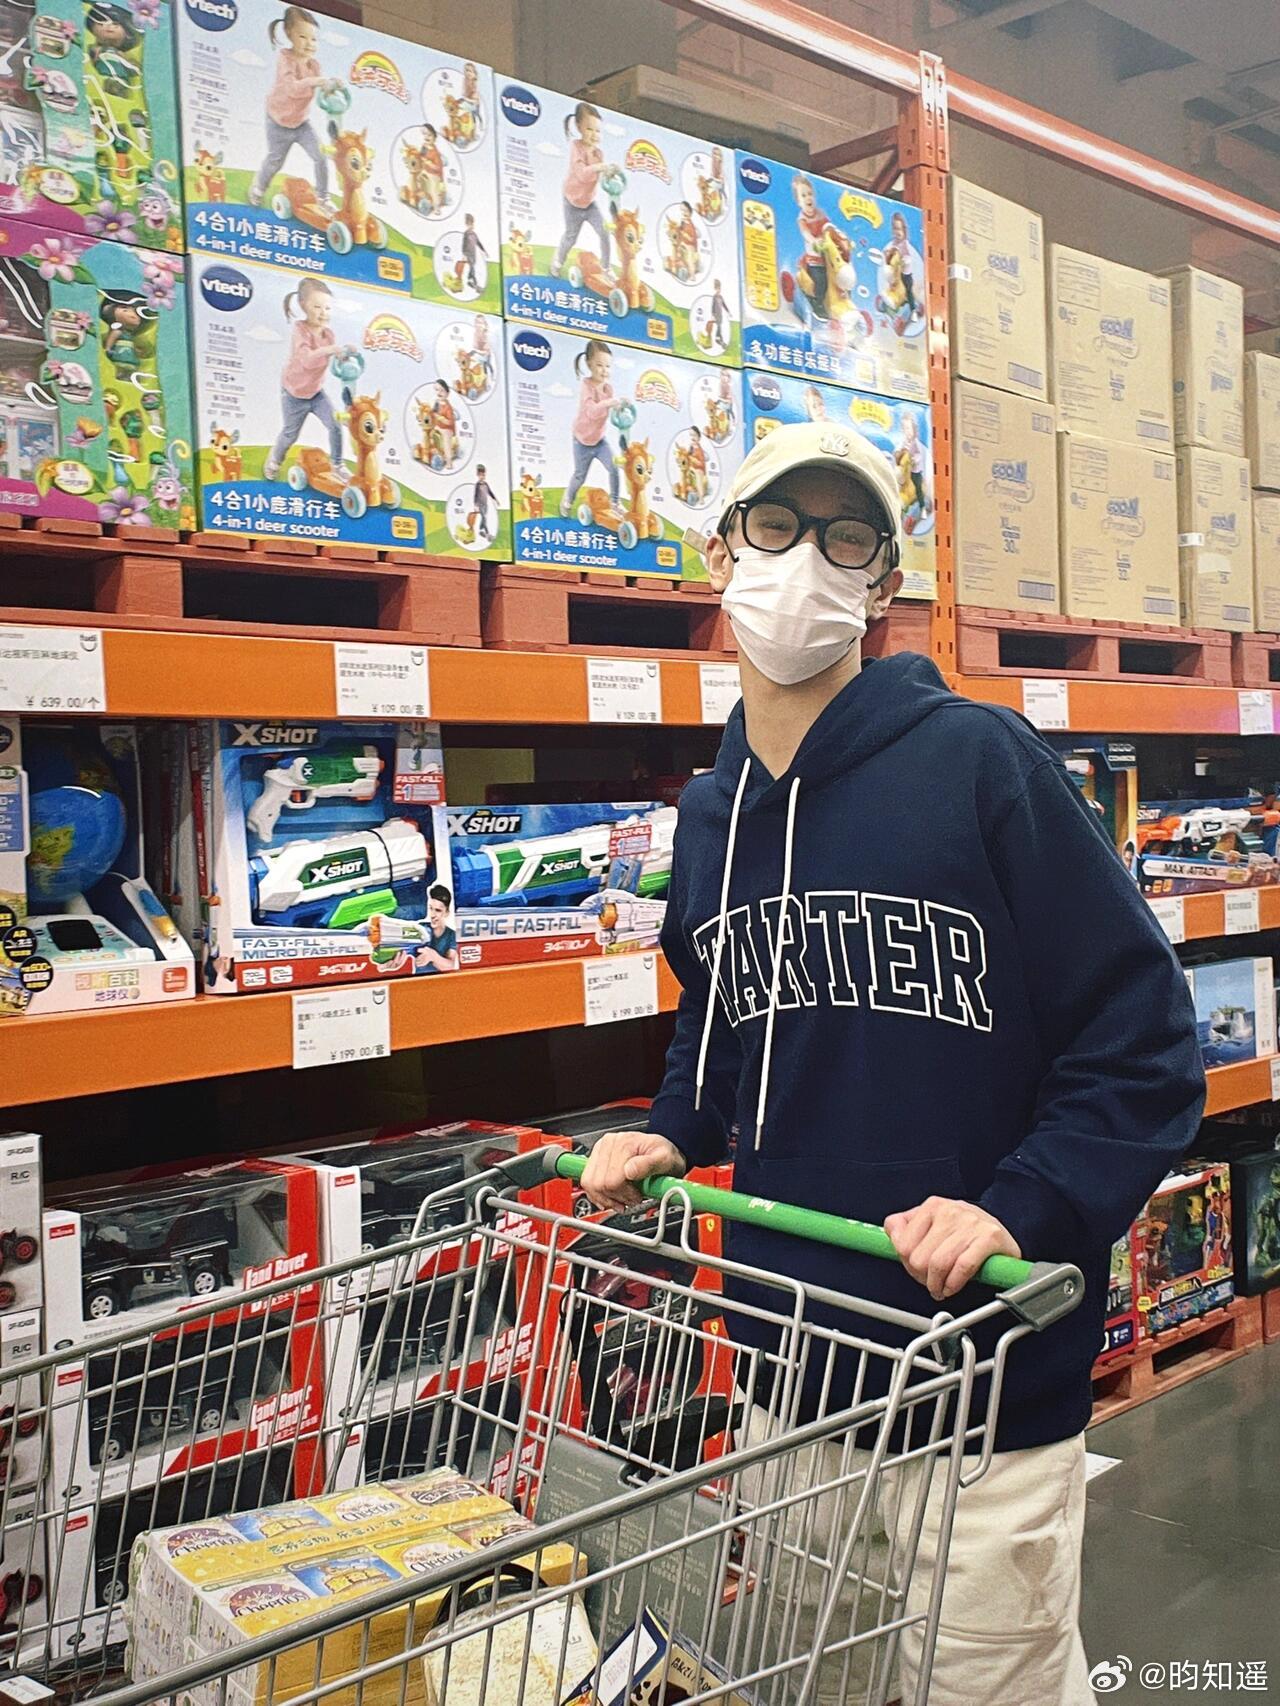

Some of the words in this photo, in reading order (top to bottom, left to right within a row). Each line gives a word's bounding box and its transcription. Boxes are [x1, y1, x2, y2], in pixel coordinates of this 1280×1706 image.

[501, 95, 539, 116] vtech
[740, 167, 770, 185] vtech
[195, 211, 327, 253] 4合1小鹿滑行车
[196, 234, 237, 253] 4-in-1
[239, 243, 273, 261] deer
[274, 252, 327, 272] scooter
[201, 277, 251, 298] vtech
[511, 302, 542, 320] 4-in-1
[543, 311, 568, 326] deer
[569, 317, 609, 333] scooter
[513, 342, 551, 360] vtech
[753, 383, 781, 401] vtech
[210, 490, 341, 520] 4合1小鹿滑行车
[212, 514, 253, 529] 4-in-1
[255, 518, 287, 533] deer
[289, 524, 340, 538] scooter
[520, 527, 618, 551] 4合1小鹿滑行车
[522, 548, 552, 560] 4-in-1
[553, 552, 578, 563] deer
[579, 555, 618, 567] scooter
[1164, 863, 1185, 874] MAX
[1187, 865, 1217, 877] ATTACK
[461, 919, 508, 938] EPIC
[513, 915, 583, 933] FAST-FILL
[242, 939, 321, 949] FAST-FILL
[242, 949, 297, 960] MICRO
[302, 946, 358, 956] FAST-FILL
[10, 1170, 31, 1181] R/C
[12, 1342, 32, 1354] R/C
[342, 1500, 402, 1523] Cheerios
